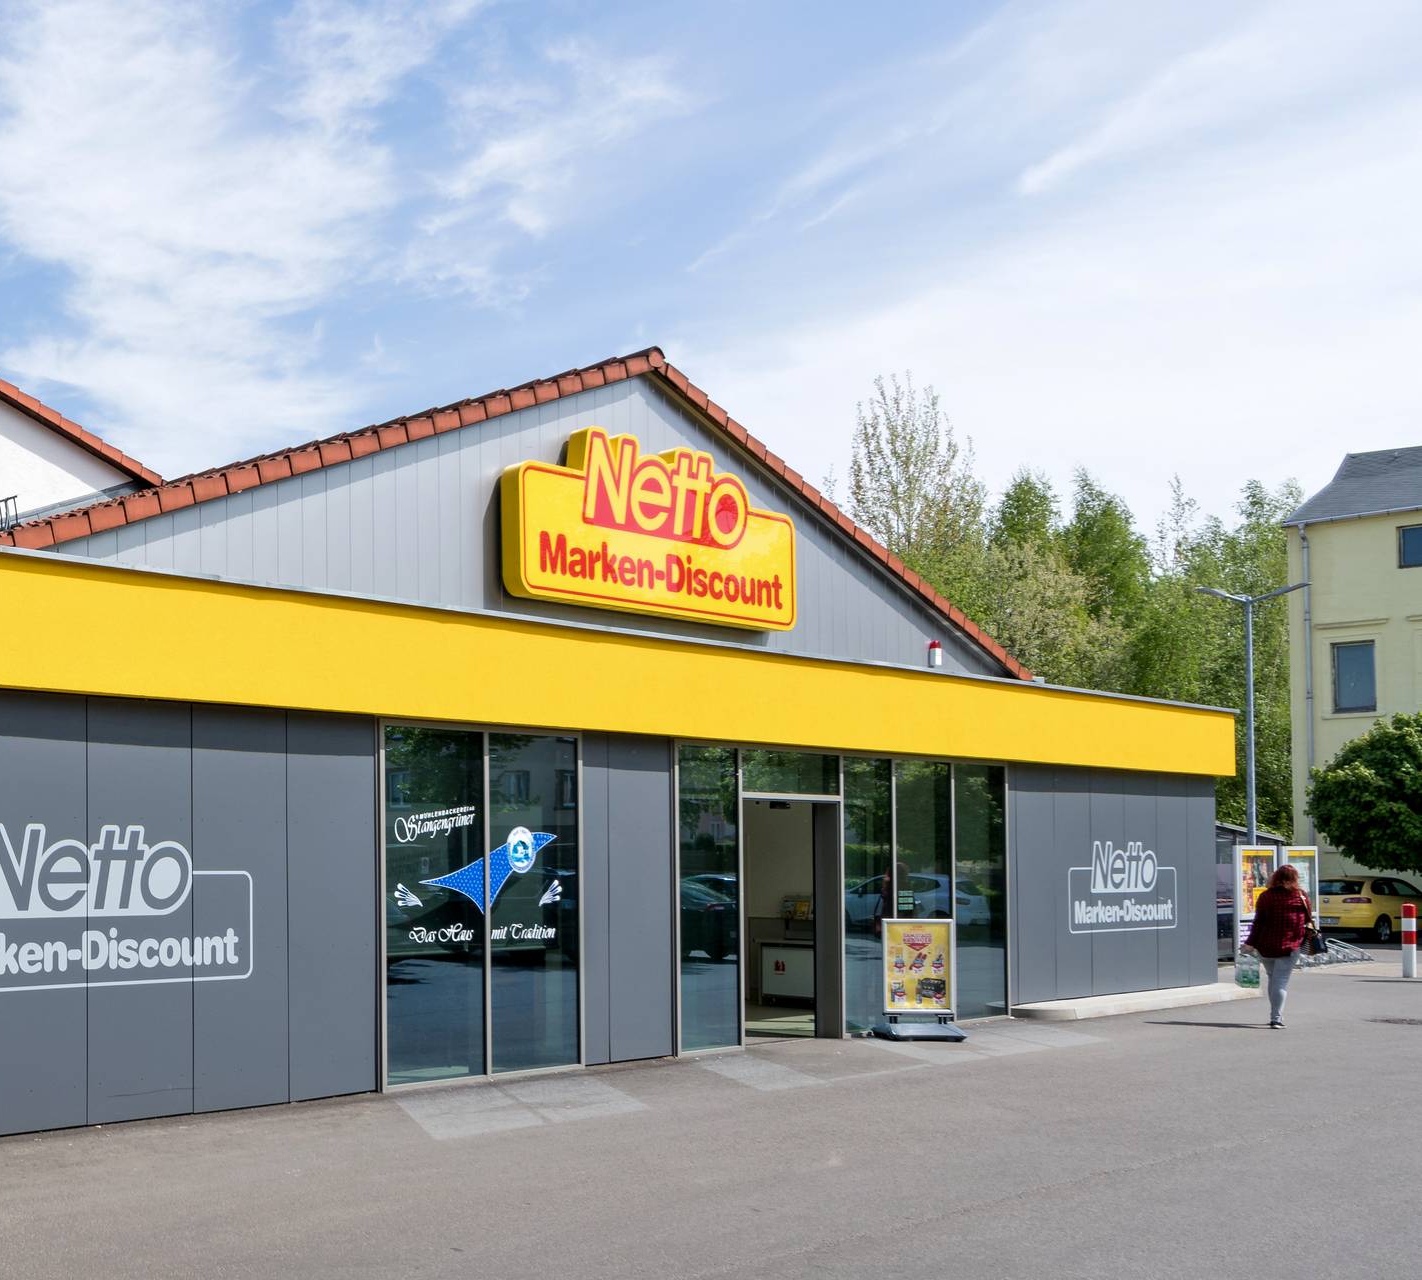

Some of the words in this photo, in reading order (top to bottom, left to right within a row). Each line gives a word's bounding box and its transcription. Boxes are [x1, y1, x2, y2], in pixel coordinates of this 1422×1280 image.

[583, 431, 748, 550] Netto
[539, 530, 783, 610] Marken-Discount
[394, 813, 476, 843] Stangengrüner
[1091, 841, 1158, 893] Netto
[1074, 898, 1173, 924] Marken-Discount
[409, 927, 437, 943] Das
[438, 923, 474, 942] Haus
[490, 926, 508, 940] mit
[509, 923, 557, 940] Tradition
